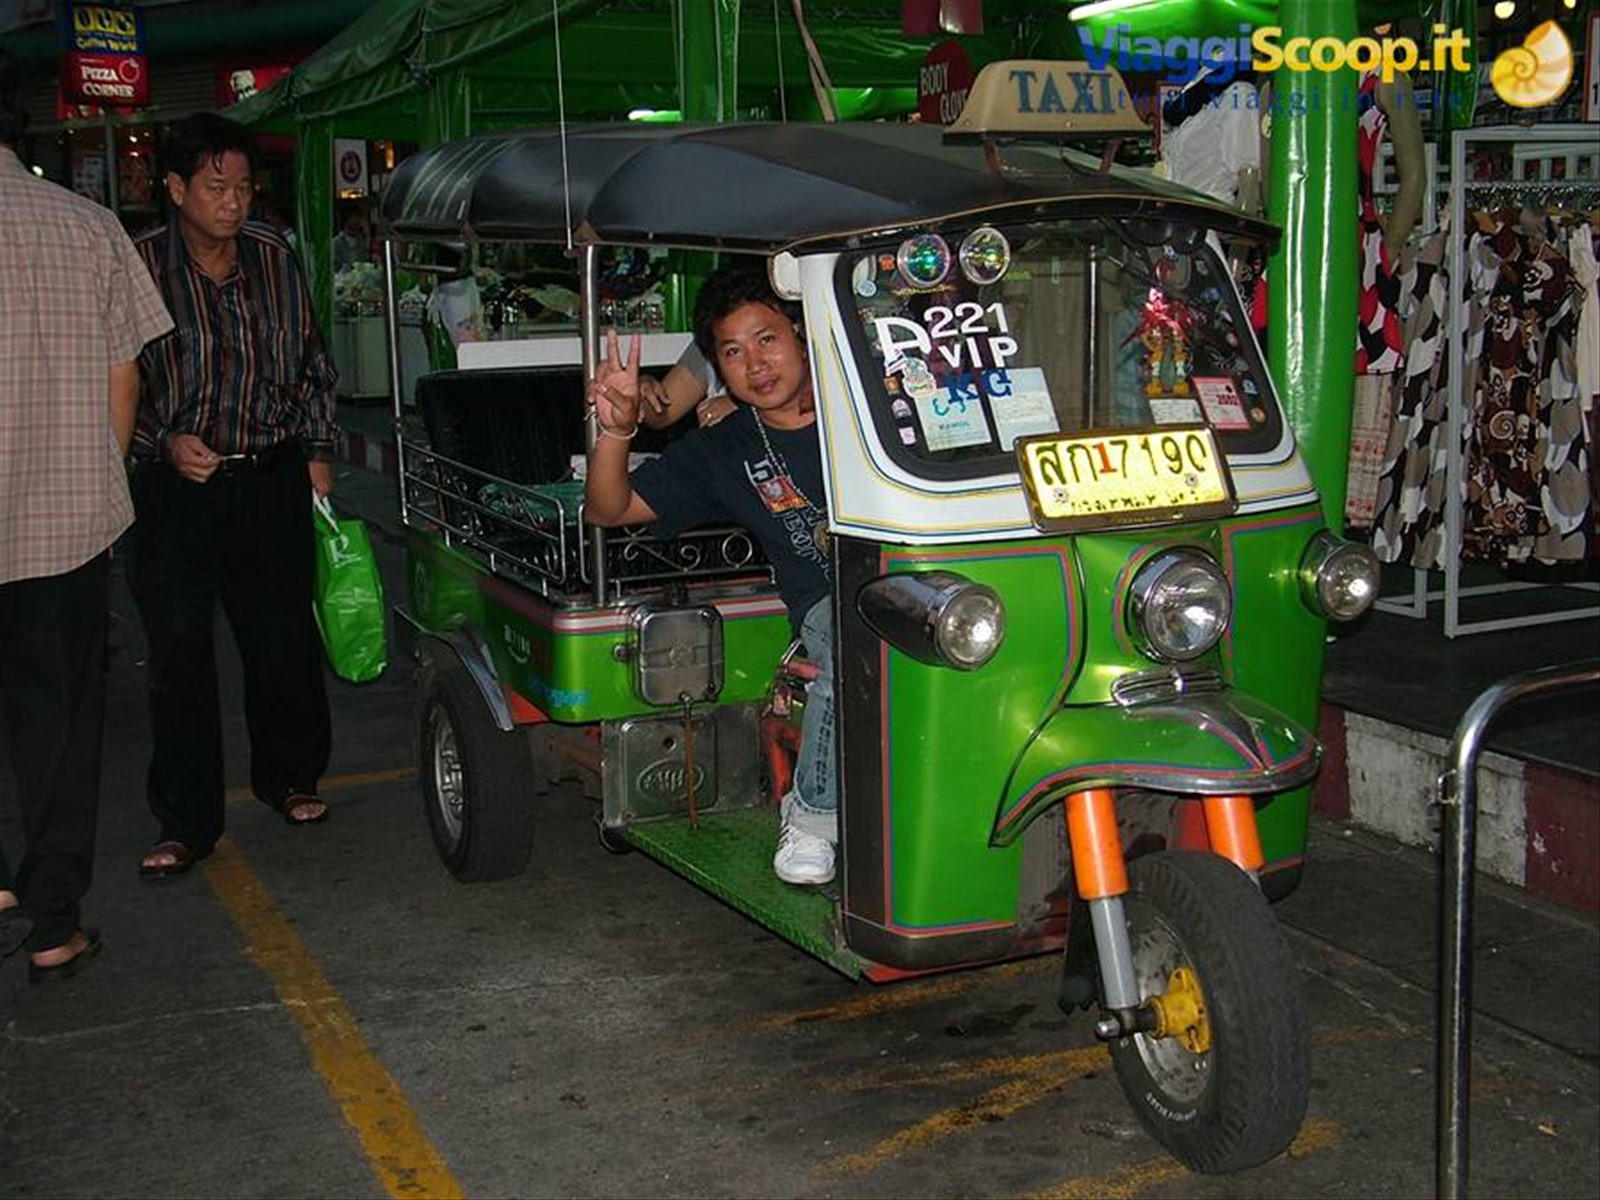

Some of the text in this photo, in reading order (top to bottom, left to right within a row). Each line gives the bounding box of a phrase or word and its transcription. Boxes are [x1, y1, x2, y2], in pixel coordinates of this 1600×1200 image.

[81, 65, 119, 81] PIZZA
[82, 81, 135, 98] CORNER
[920, 62, 949, 96] BODY
[1009, 71, 1115, 114] TAXI
[923, 302, 1009, 339] 221
